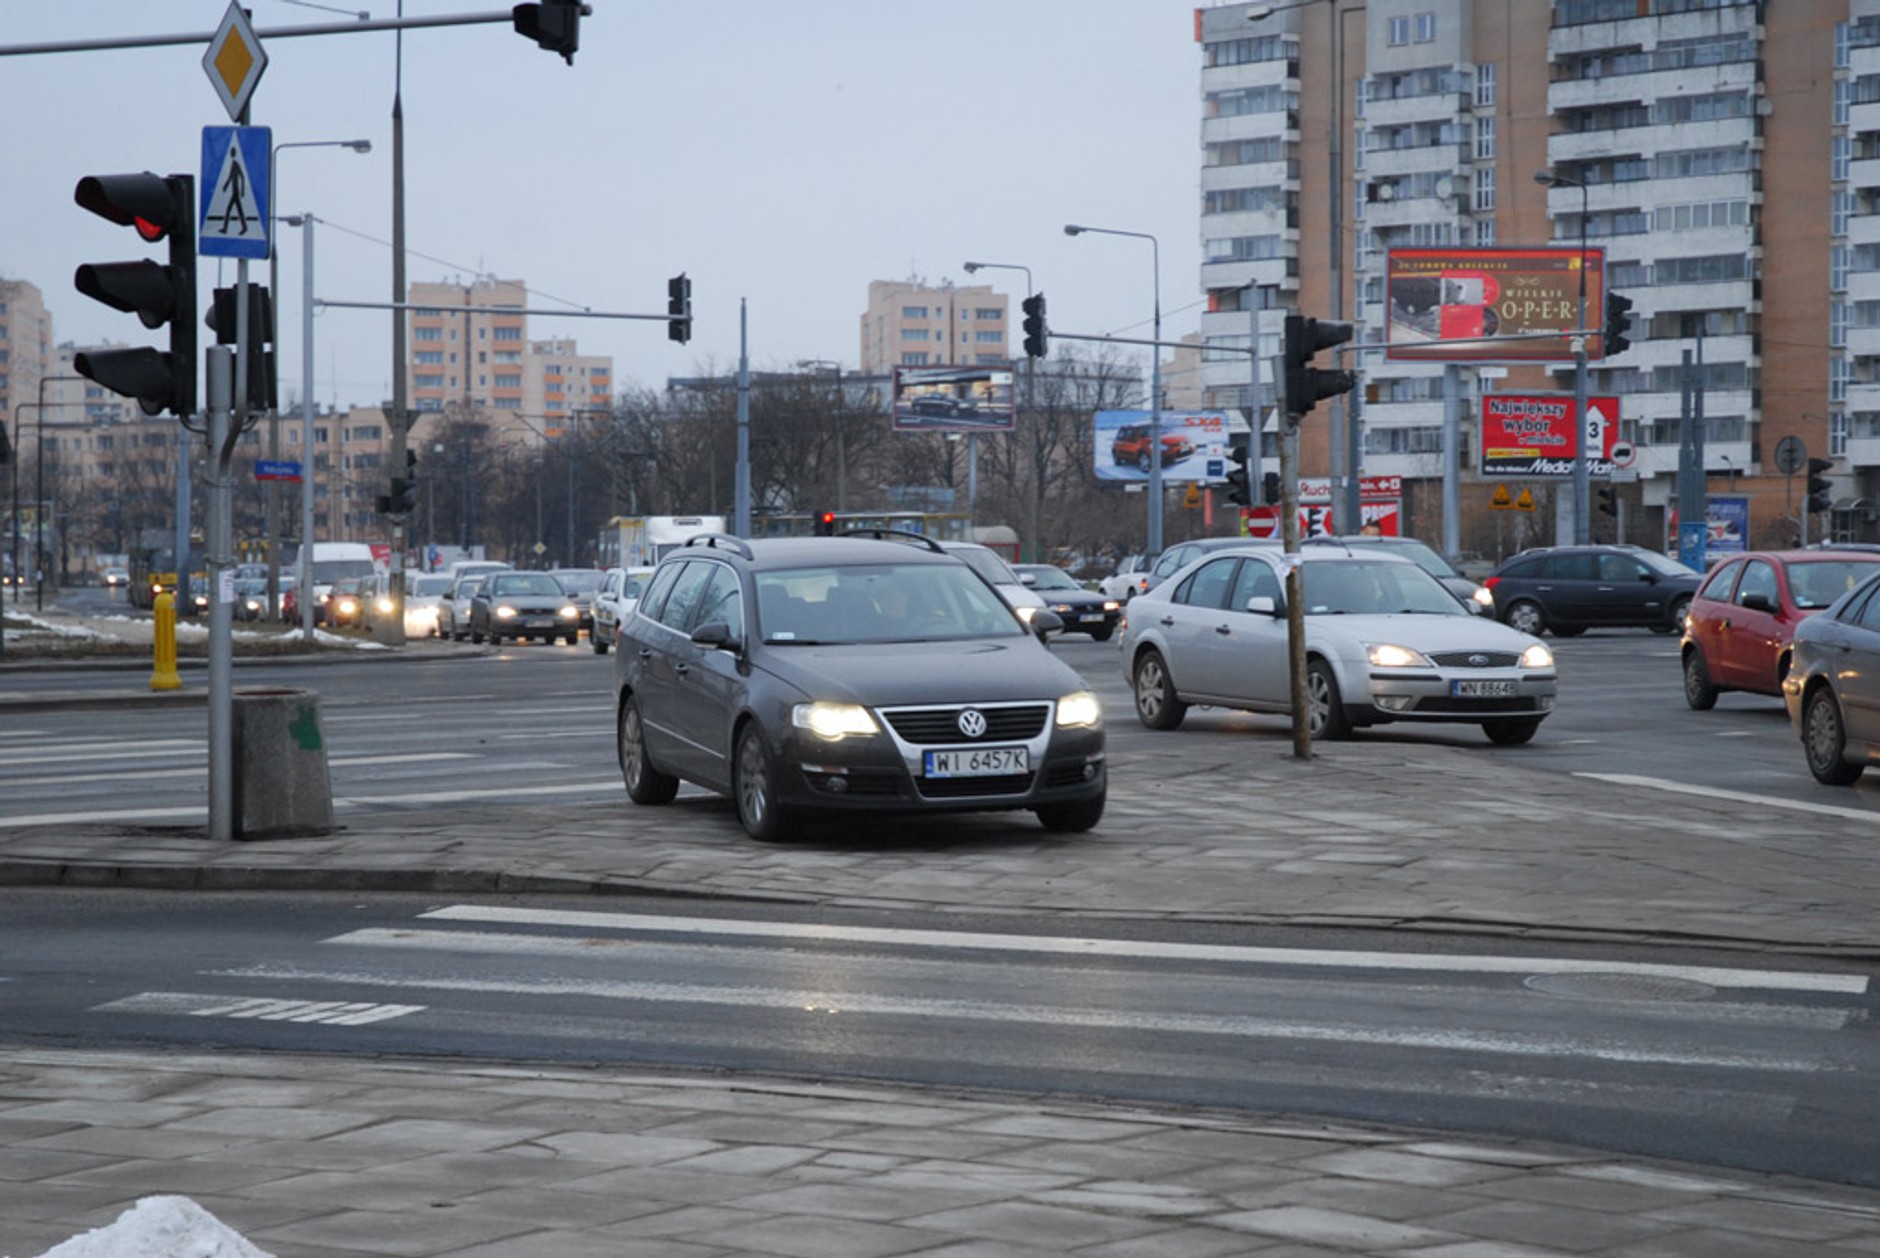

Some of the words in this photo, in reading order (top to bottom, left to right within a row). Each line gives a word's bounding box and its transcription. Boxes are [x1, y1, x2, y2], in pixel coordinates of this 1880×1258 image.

[1505, 289, 1563, 298] WIELKIE
[1490, 401, 1567, 418] Największy
[1503, 416, 1550, 435] wybór
[1588, 422, 1599, 438] 3
[936, 753, 960, 773] WI
[969, 751, 1024, 771] 6457K
